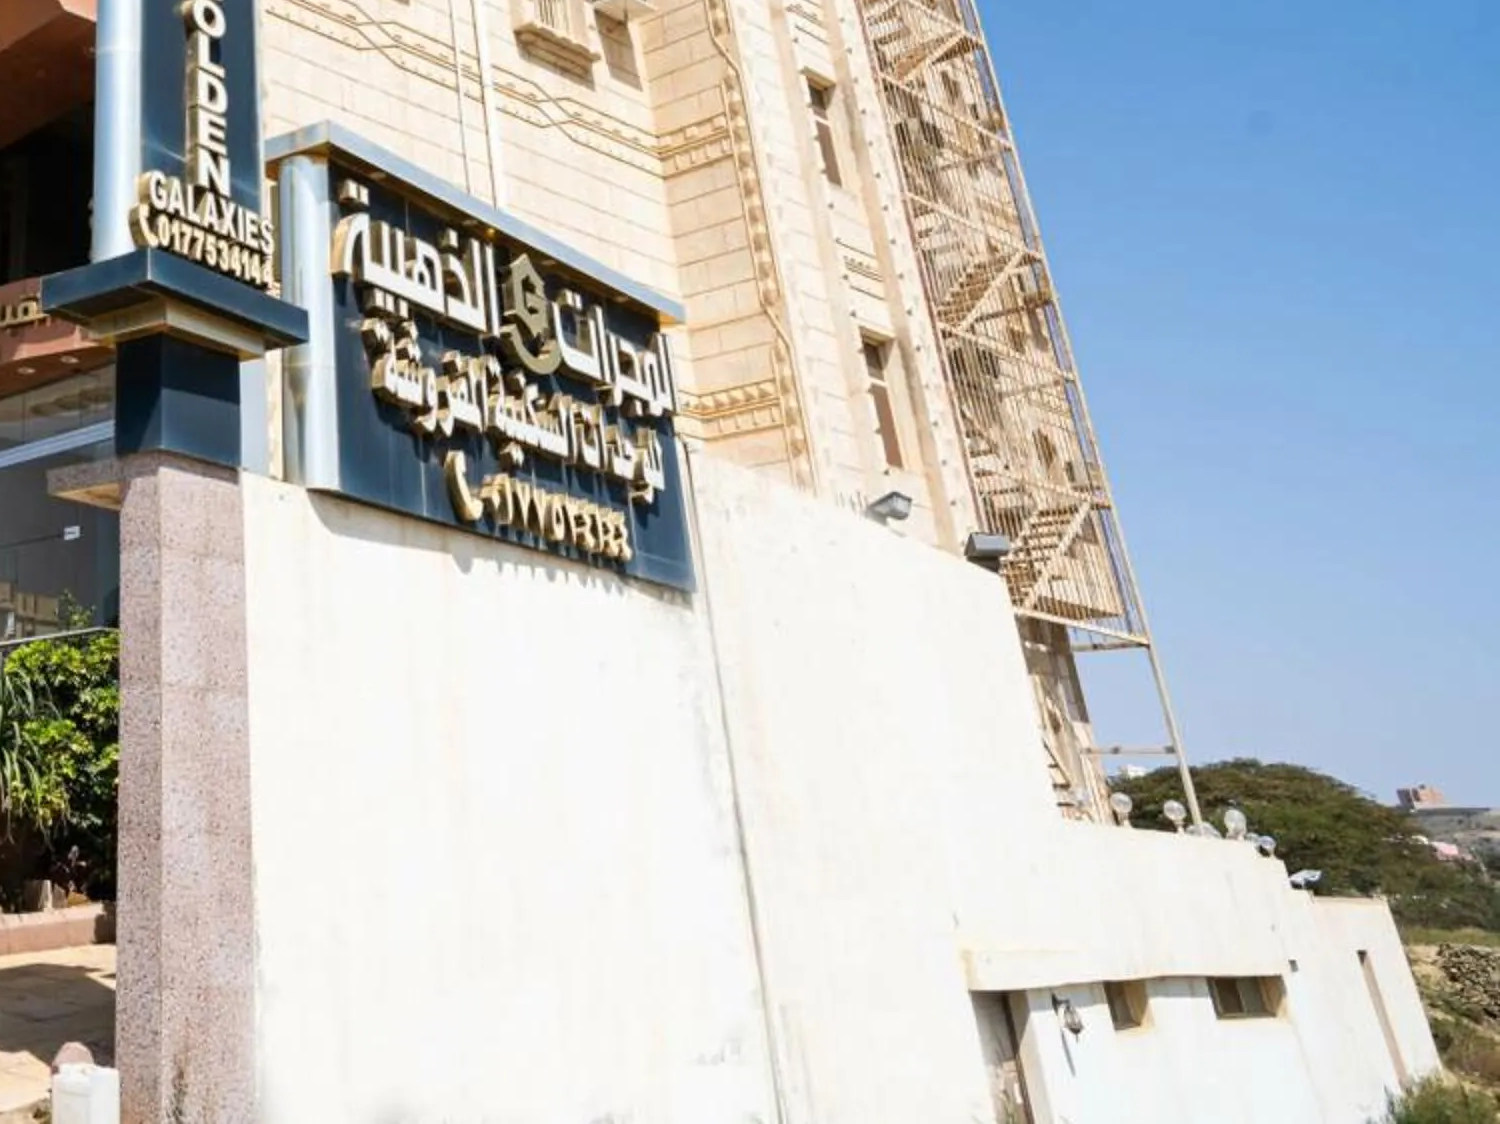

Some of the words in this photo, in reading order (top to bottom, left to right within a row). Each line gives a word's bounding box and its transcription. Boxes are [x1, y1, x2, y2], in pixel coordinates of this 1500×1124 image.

[147, 170, 275, 256] GALAXIES
[334, 179, 498, 335] الذهبية
[362, 318, 488, 437] المفروشة
[553, 288, 678, 417] المجرات
[489, 356, 577, 467] السكنية
[575, 402, 665, 504] للوحدات
